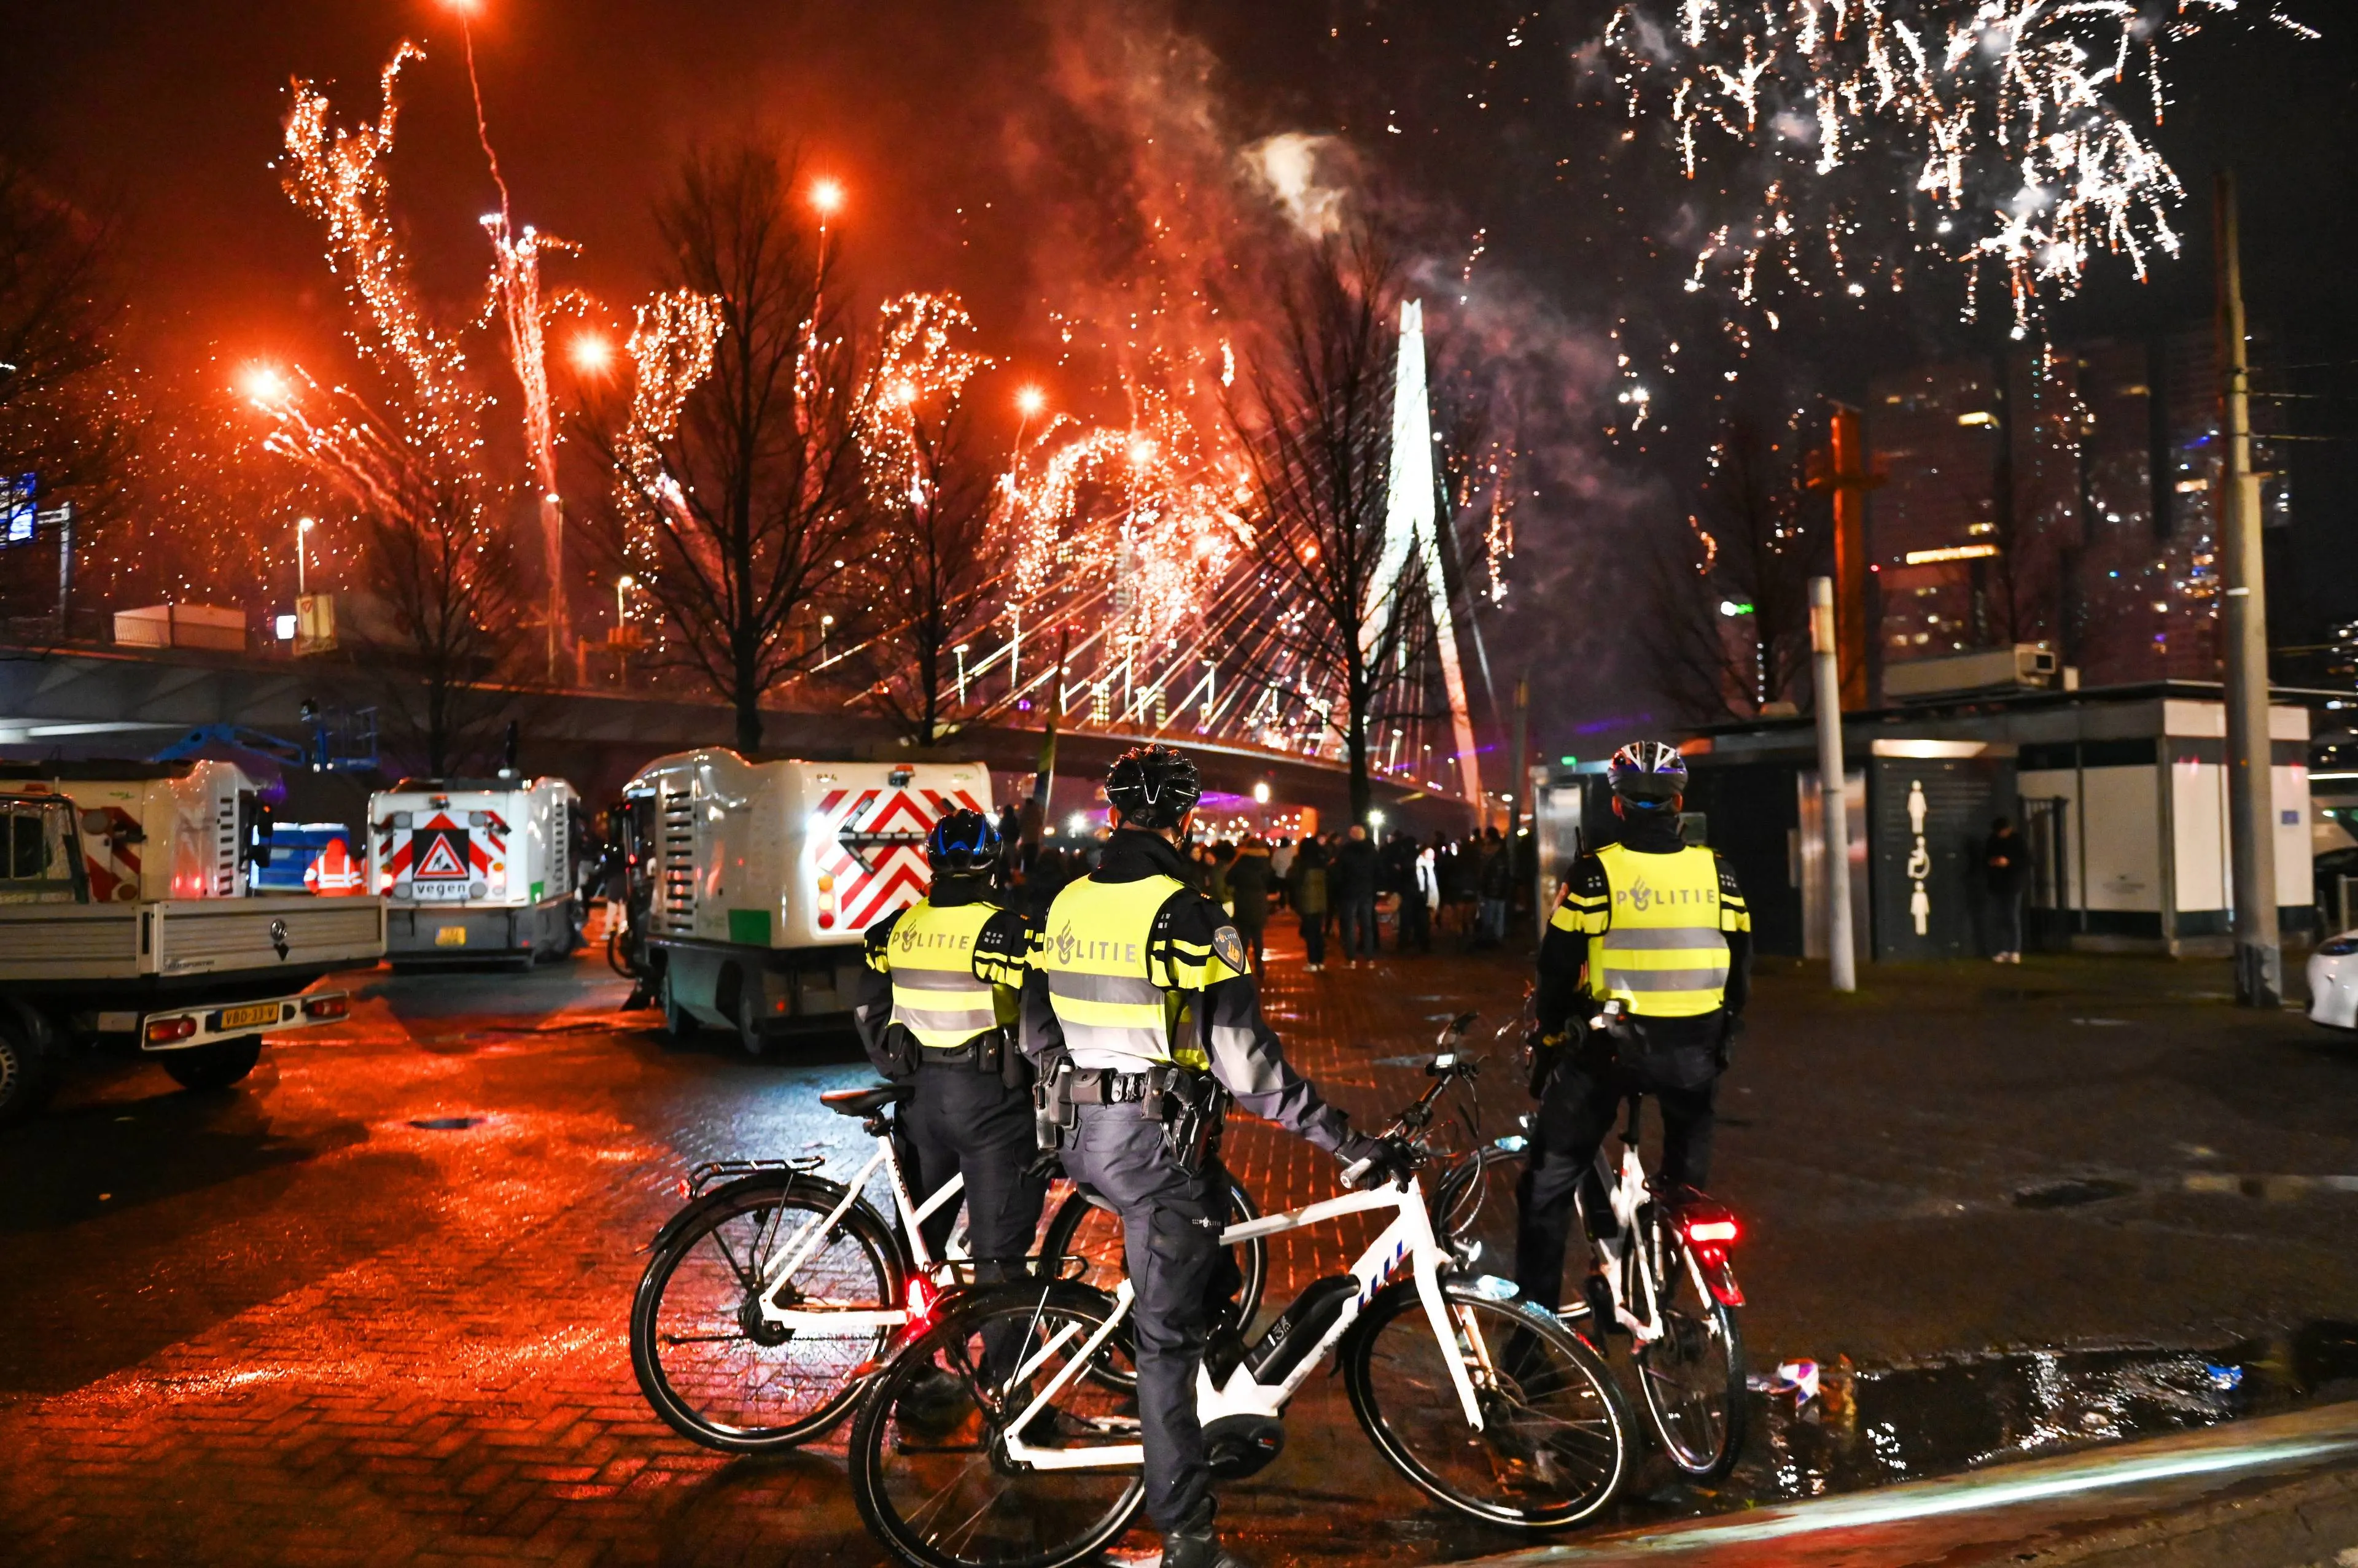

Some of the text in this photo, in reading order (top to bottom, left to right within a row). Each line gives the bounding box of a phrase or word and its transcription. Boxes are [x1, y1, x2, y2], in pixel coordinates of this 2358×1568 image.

[418, 883, 465, 896] vegen
[1616, 885, 1715, 911] POLITIE
[892, 925, 970, 952] POLITIE
[1046, 925, 1136, 964] POLITIE
